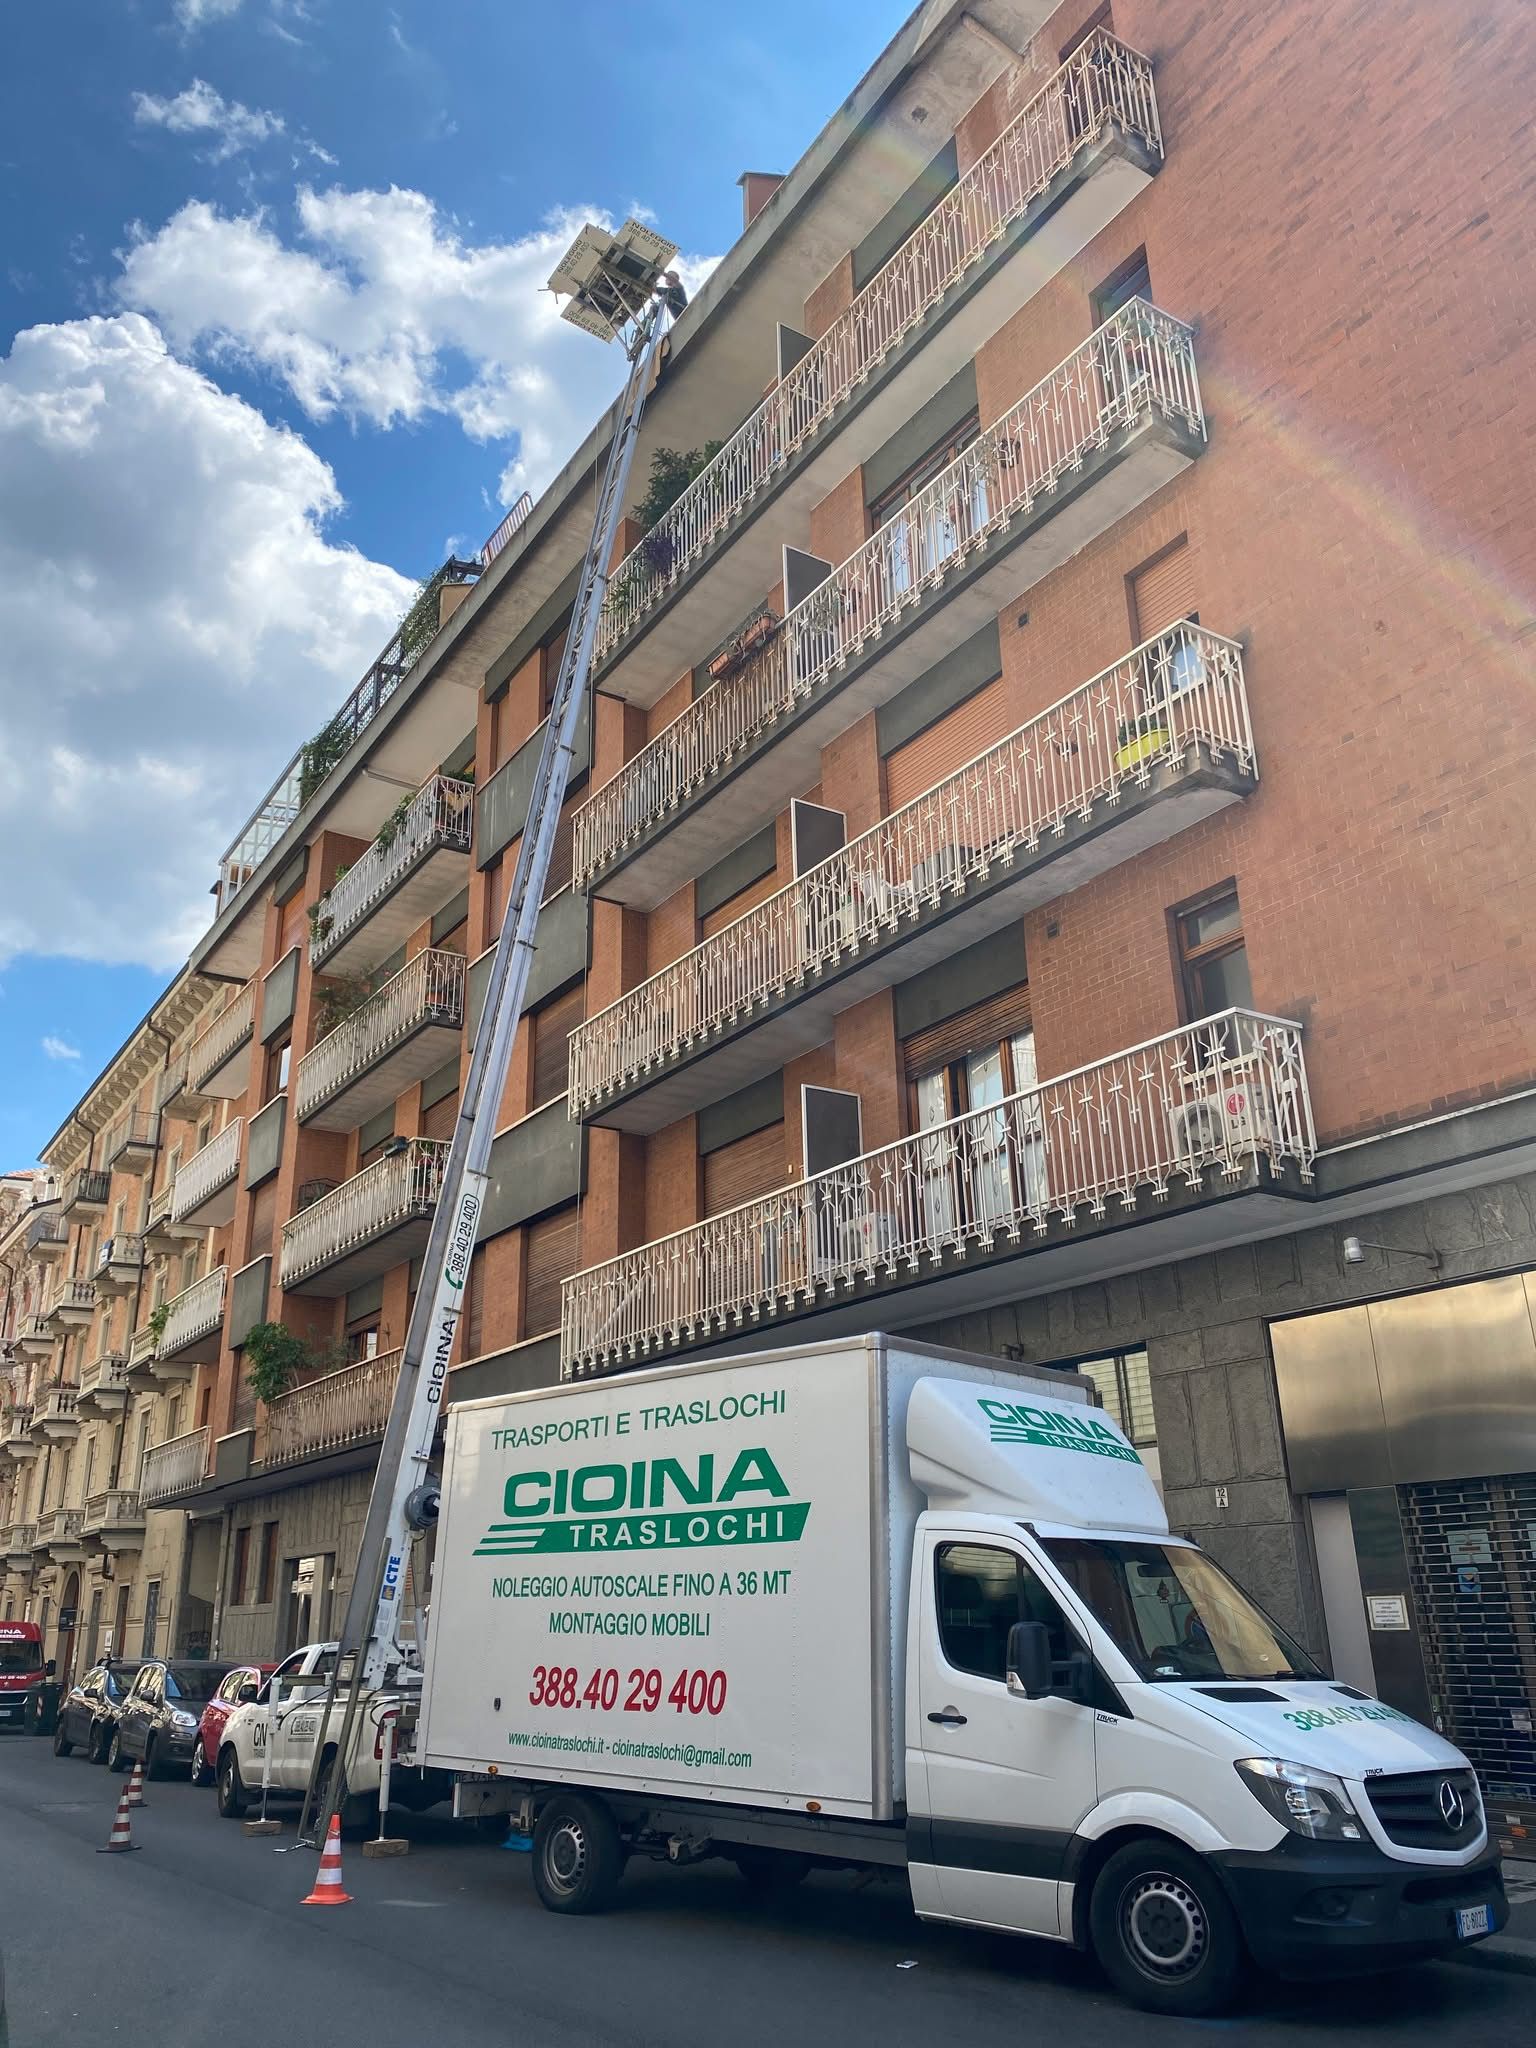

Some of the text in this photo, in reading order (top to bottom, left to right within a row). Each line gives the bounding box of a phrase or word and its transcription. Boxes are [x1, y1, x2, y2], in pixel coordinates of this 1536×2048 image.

[631, 222, 676, 250] NOLEGGIO
[450, 1200, 477, 1276] 388 40 29 400
[491, 1389, 786, 1450] TRASPORTI E TRASLOCHI
[977, 1398, 1125, 1446] CIOINA
[1039, 1432, 1138, 1462] TRASLOCHI
[503, 1447, 791, 1518] CIOINA
[1217, 1488, 1226, 1497] 12
[1219, 1498, 1226, 1506] A
[569, 1510, 784, 1549] TRASLOCHI
[385, 1556, 401, 1584] CTE
[492, 1570, 791, 1598] NOLEGGIO AUTOSCALE FINO A 36 MT
[549, 1612, 710, 1636] MONTAGGIO MOBILI
[529, 1665, 727, 1716] 388.40 29 400
[1096, 1713, 1119, 1725] TRUCK
[508, 1732, 605, 1754] www.cioinatraslochi.it
[612, 1738, 752, 1768] cioinatraslochi@gmail.com
[1365, 1768, 1384, 1778] TRUCK
